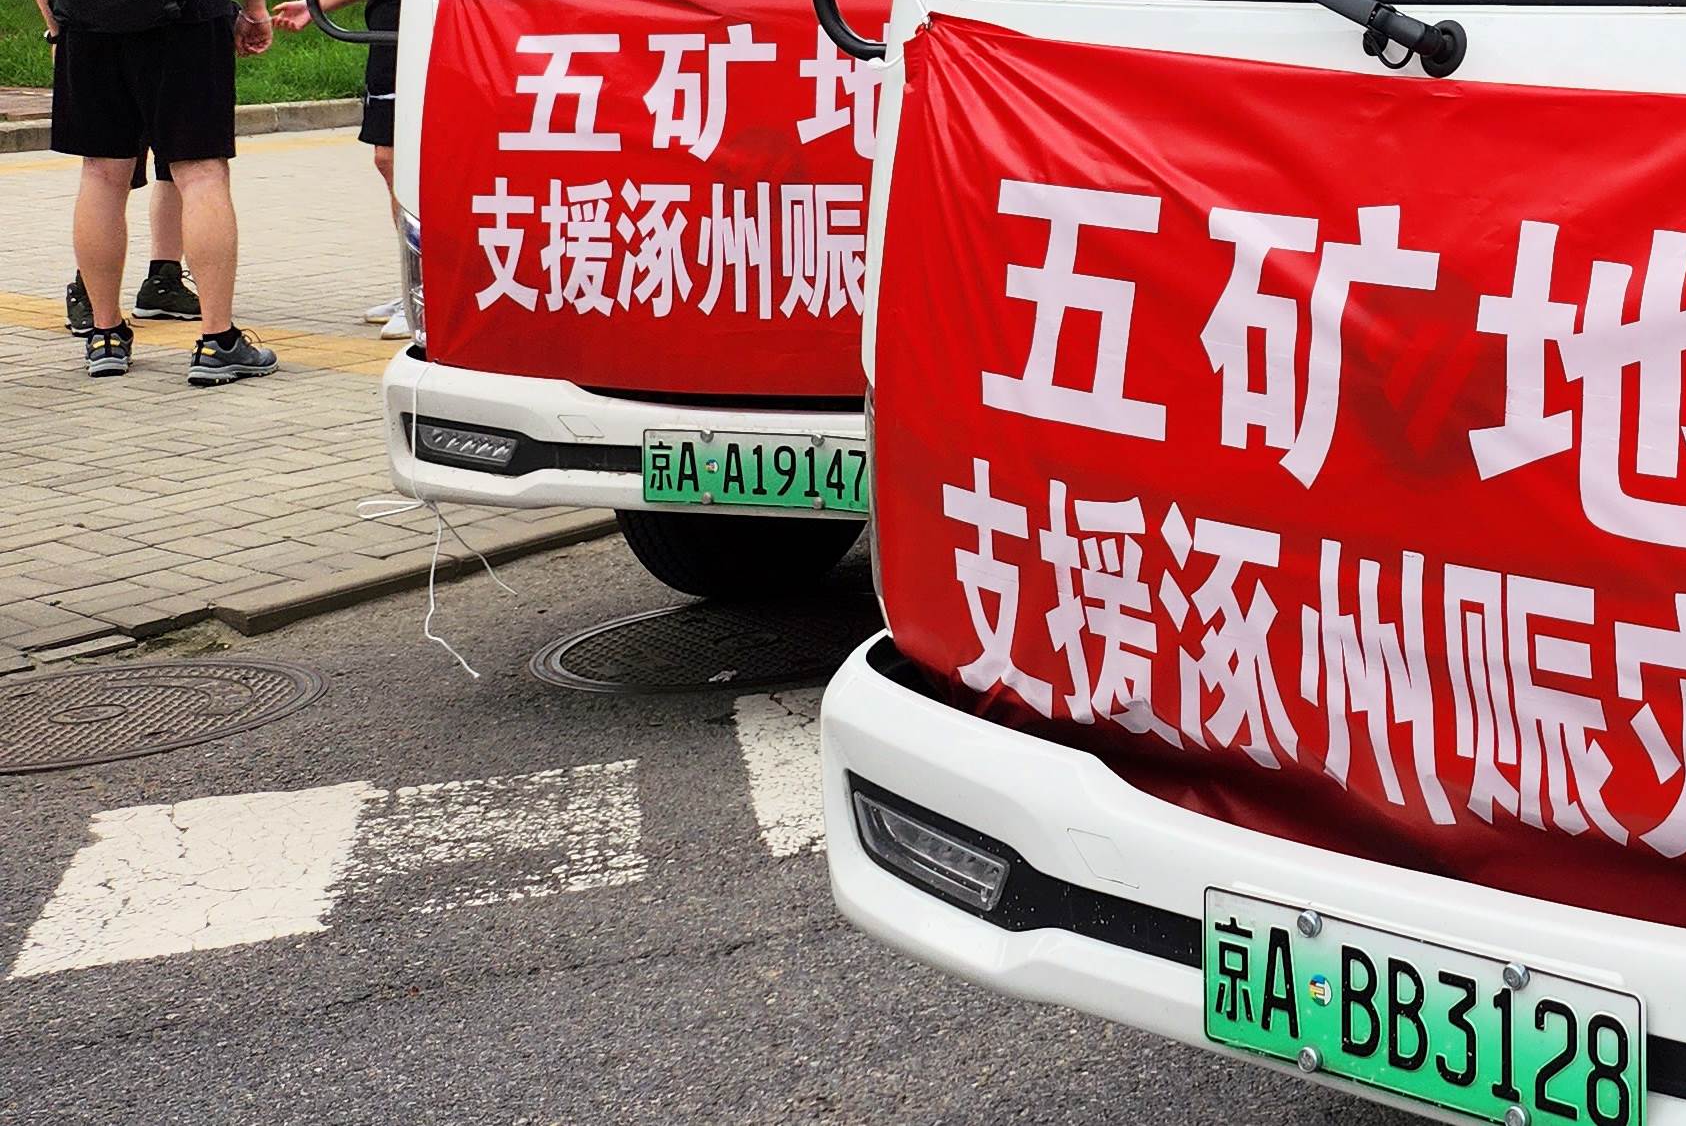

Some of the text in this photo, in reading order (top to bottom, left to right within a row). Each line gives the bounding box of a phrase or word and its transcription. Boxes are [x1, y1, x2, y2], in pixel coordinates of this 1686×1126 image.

[472, 177, 866, 320] 支援涿州赈
